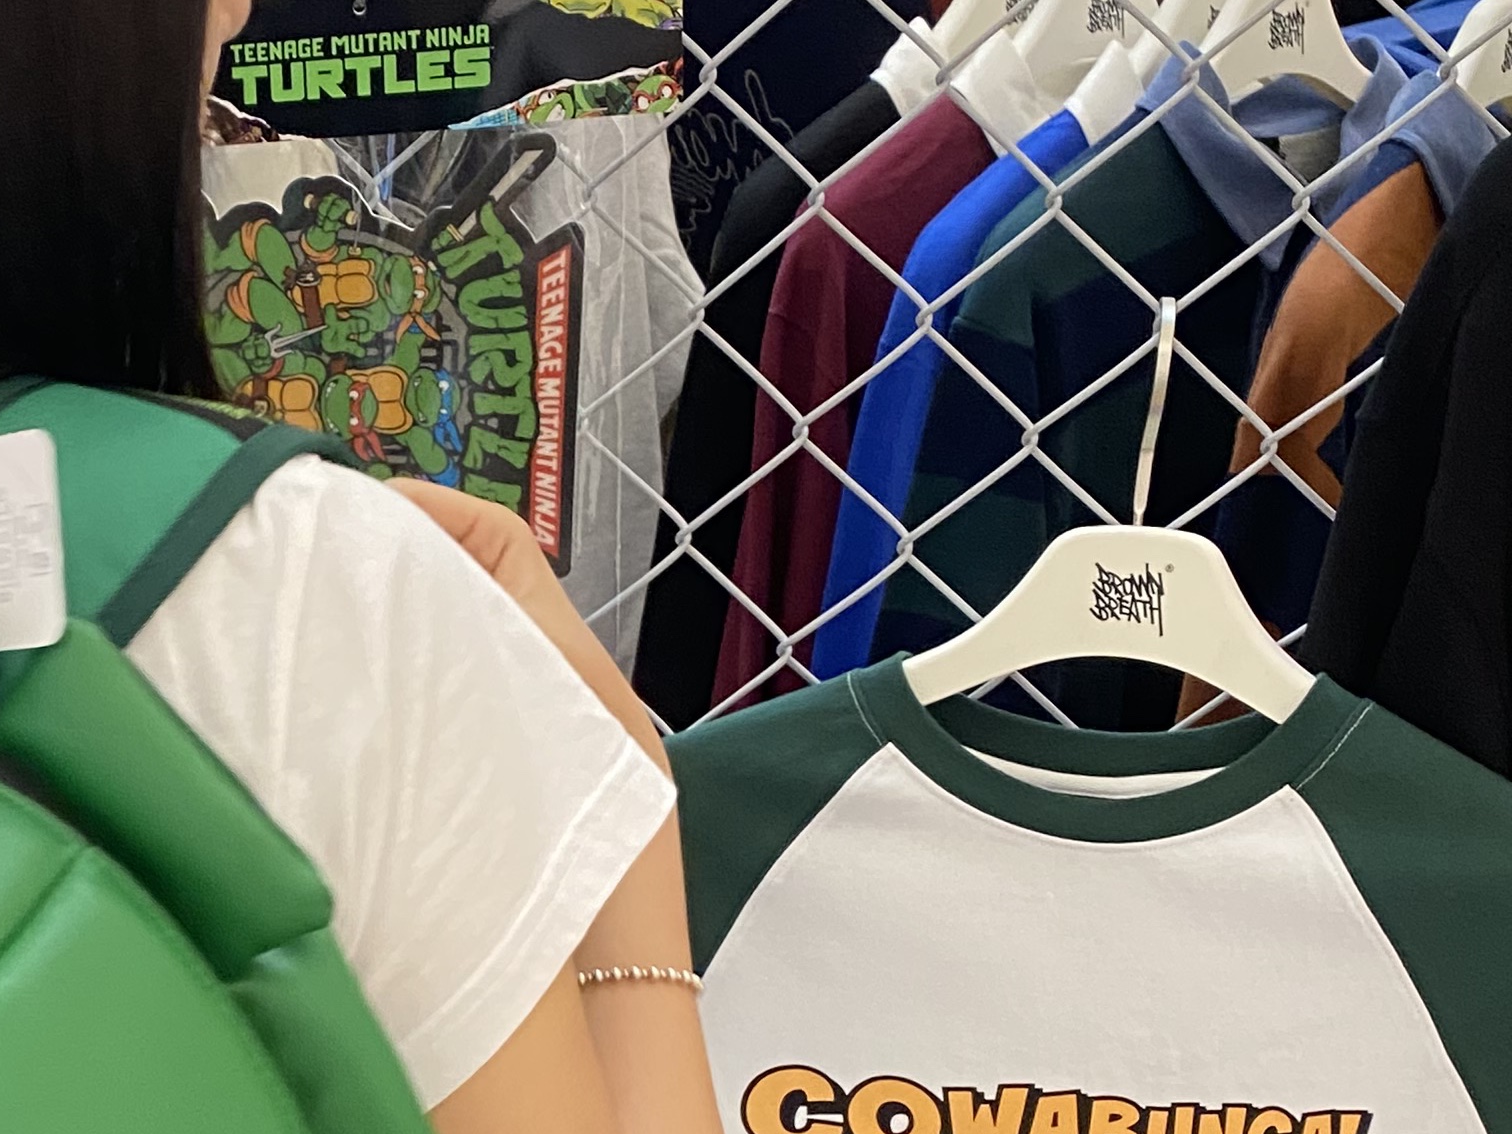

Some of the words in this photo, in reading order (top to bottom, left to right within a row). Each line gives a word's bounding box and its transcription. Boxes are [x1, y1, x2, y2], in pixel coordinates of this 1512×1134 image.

[230, 37, 325, 63] TEENAGE
[331, 29, 421, 55] MUTANT
[425, 24, 490, 48] NINJA
[231, 47, 491, 105] TURTLES
[538, 249, 567, 373] TEENAGE
[534, 377, 563, 471] MUTANT
[533, 471, 558, 546] NINJA
[1092, 562, 1164, 597] BROWN
[1089, 588, 1164, 636] BREATH
